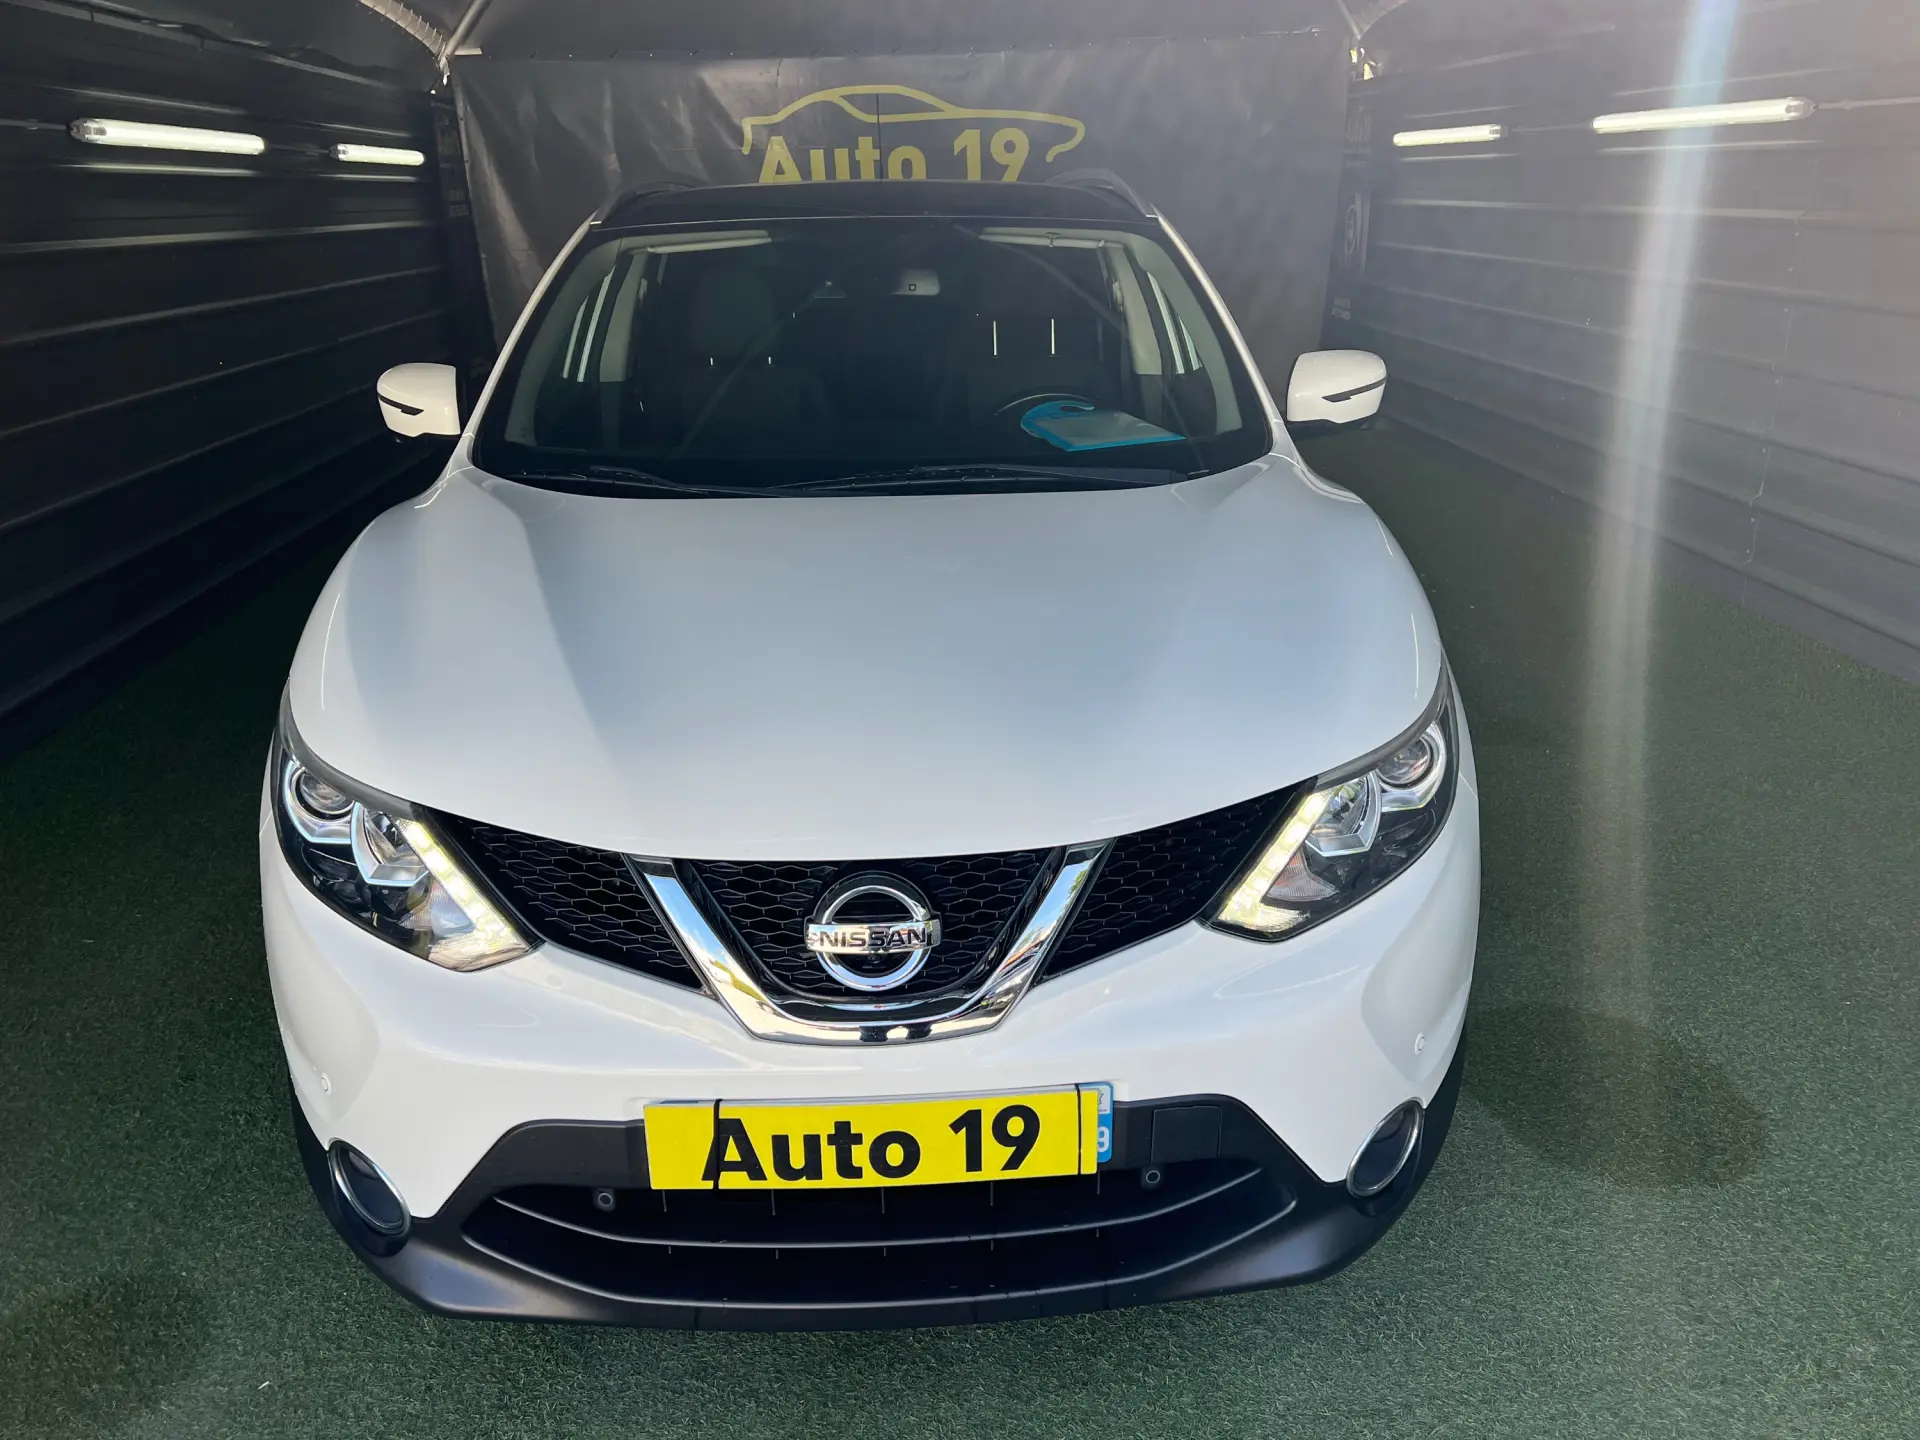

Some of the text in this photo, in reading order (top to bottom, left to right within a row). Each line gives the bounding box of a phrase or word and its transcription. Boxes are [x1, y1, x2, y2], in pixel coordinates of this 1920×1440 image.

[758, 128, 1029, 183] Auto 19
[819, 928, 925, 948] NISSAN
[701, 1104, 1041, 1182] Auto 19
